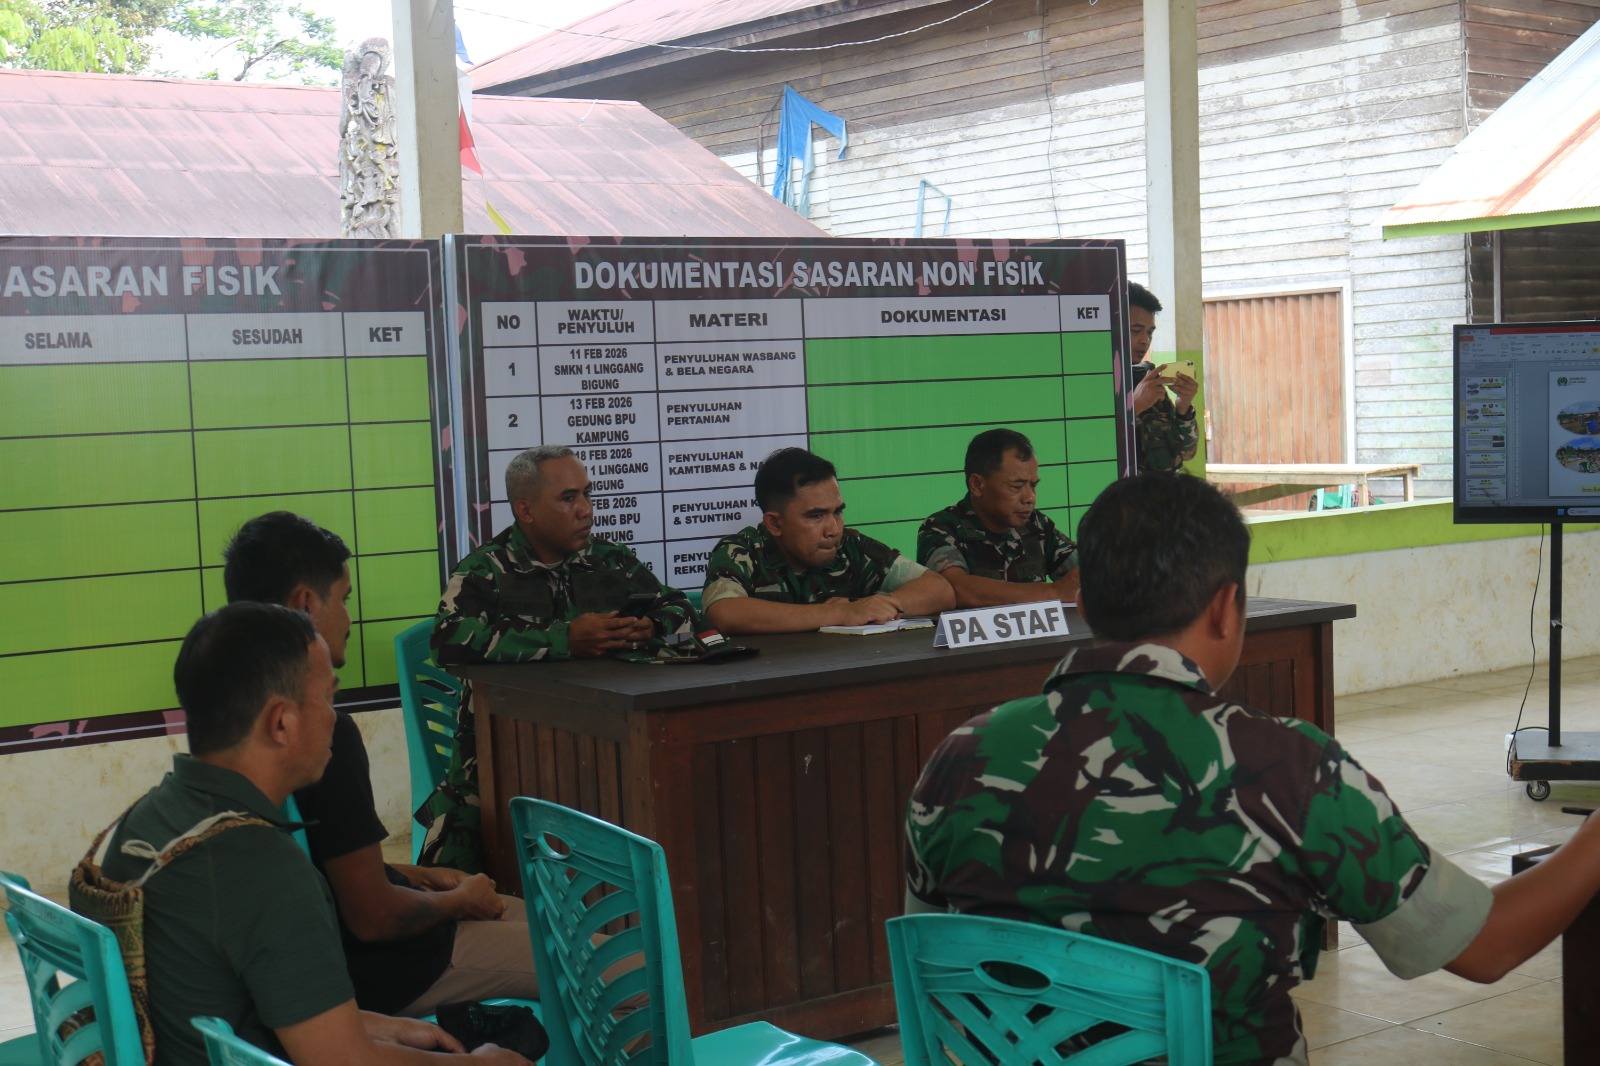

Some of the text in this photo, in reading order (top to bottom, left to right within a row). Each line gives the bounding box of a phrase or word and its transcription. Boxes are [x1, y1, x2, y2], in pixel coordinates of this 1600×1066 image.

[0, 265, 282, 298] ASARAN FISIK
[574, 261, 1045, 290] DOKUMENTASI SASARAN NON FISIK
[567, 308, 624, 322] WAKTU/
[689, 312, 769, 328] MATERI
[880, 308, 1007, 324] DOKUMENTASI
[1077, 306, 1100, 320] KET
[496, 314, 521, 331] NO
[557, 321, 635, 335] PENYULUH
[24, 332, 93, 350] SELAMA
[232, 328, 303, 346] SESUDAH
[369, 327, 403, 343] KET
[569, 347, 628, 360] 11 FEB 2026
[664, 351, 796, 365] PENYULUHAN WASBANG
[508, 362, 516, 377] 1
[554, 362, 644, 376] SMKN 1 LINGGANG
[665, 364, 755, 377] & BELA NEGARA
[581, 378, 620, 391] BIGUNG
[569, 396, 633, 410] 13 FEB 2026
[666, 401, 743, 414] PENYULUHAN
[507, 414, 519, 428] 2
[567, 413, 637, 427] GEDUNG BPU
[667, 414, 731, 426] PERTANIAN
[576, 430, 630, 444] KAMPUNG
[589, 449, 608, 460] FEB
[610, 448, 633, 459] 2026
[668, 451, 744, 463] PENYULUHAN
[598, 462, 649, 475] LINGGANG
[669, 463, 736, 476] KAMTIBMAS
[738, 462, 747, 471] &
[612, 497, 638, 509] 2026
[672, 499, 748, 513] PENYULUHAN
[620, 513, 641, 525] BPU
[673, 512, 742, 525] & STUNTING
[673, 551, 711, 563] PENYU
[948, 606, 1060, 645] PA STAF
